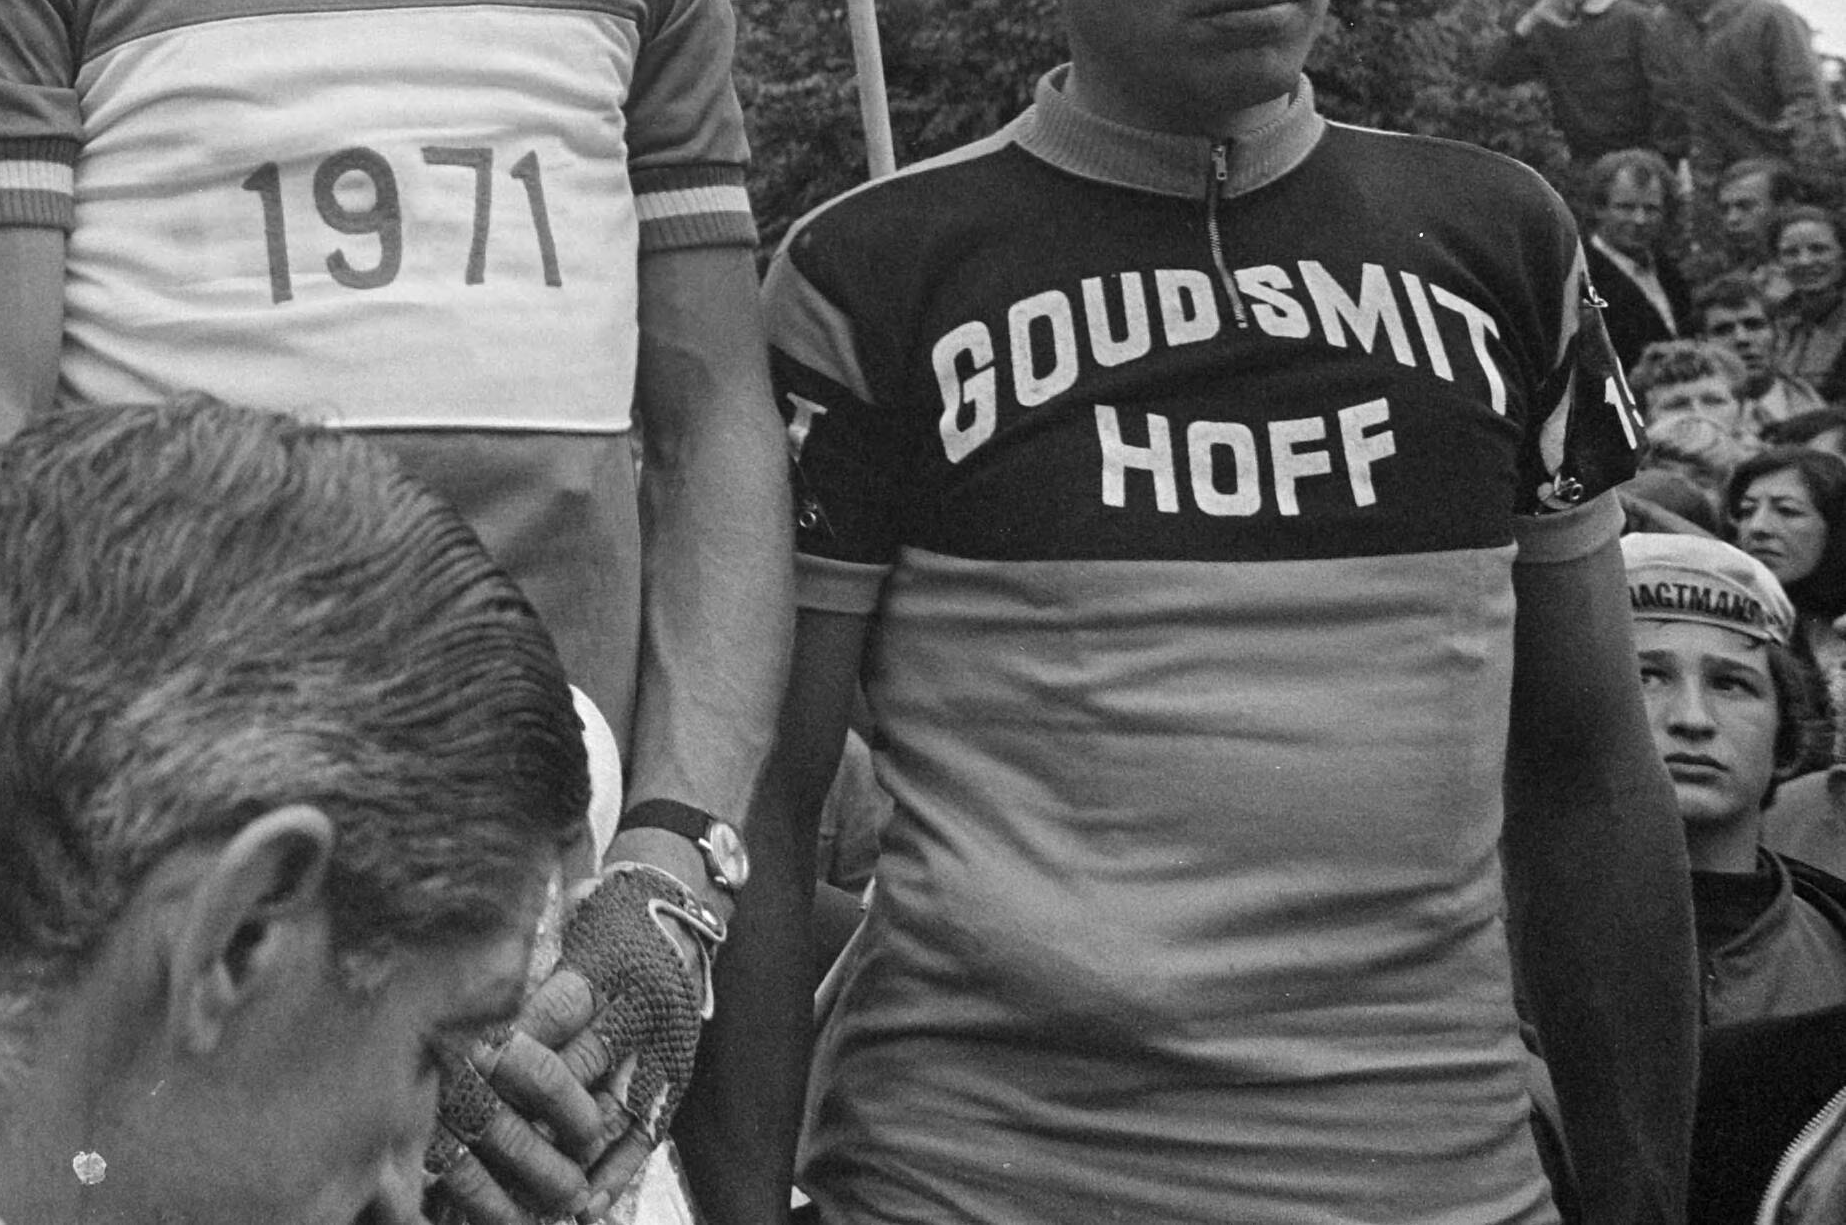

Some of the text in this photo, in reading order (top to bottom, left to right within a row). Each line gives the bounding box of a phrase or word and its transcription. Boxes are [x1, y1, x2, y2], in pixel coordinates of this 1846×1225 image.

[242, 146, 562, 305] 1971
[932, 260, 1507, 464] GOUDSMIT
[1094, 398, 1397, 517] HOFF
